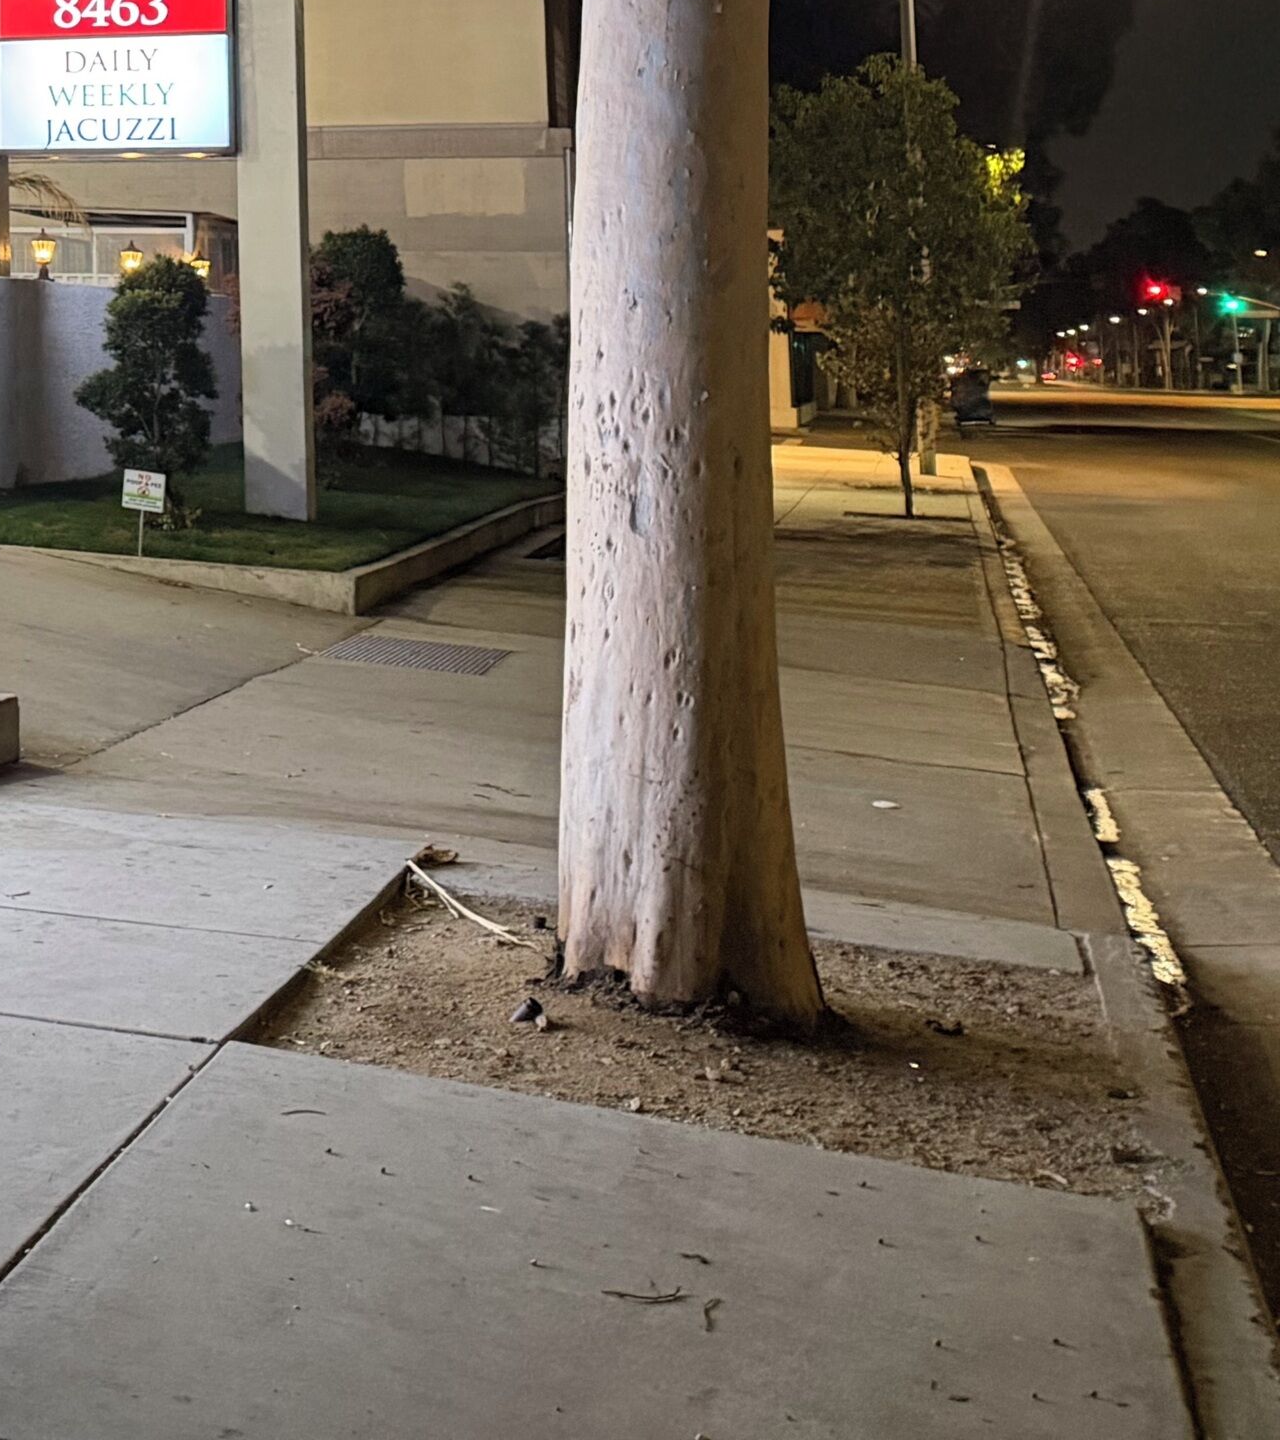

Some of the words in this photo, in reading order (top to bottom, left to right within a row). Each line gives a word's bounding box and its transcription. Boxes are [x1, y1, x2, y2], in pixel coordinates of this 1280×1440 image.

[64, 48, 158, 74] DAILY
[48, 82, 174, 107] WEEKLY
[44, 117, 179, 150] JACUZZI
